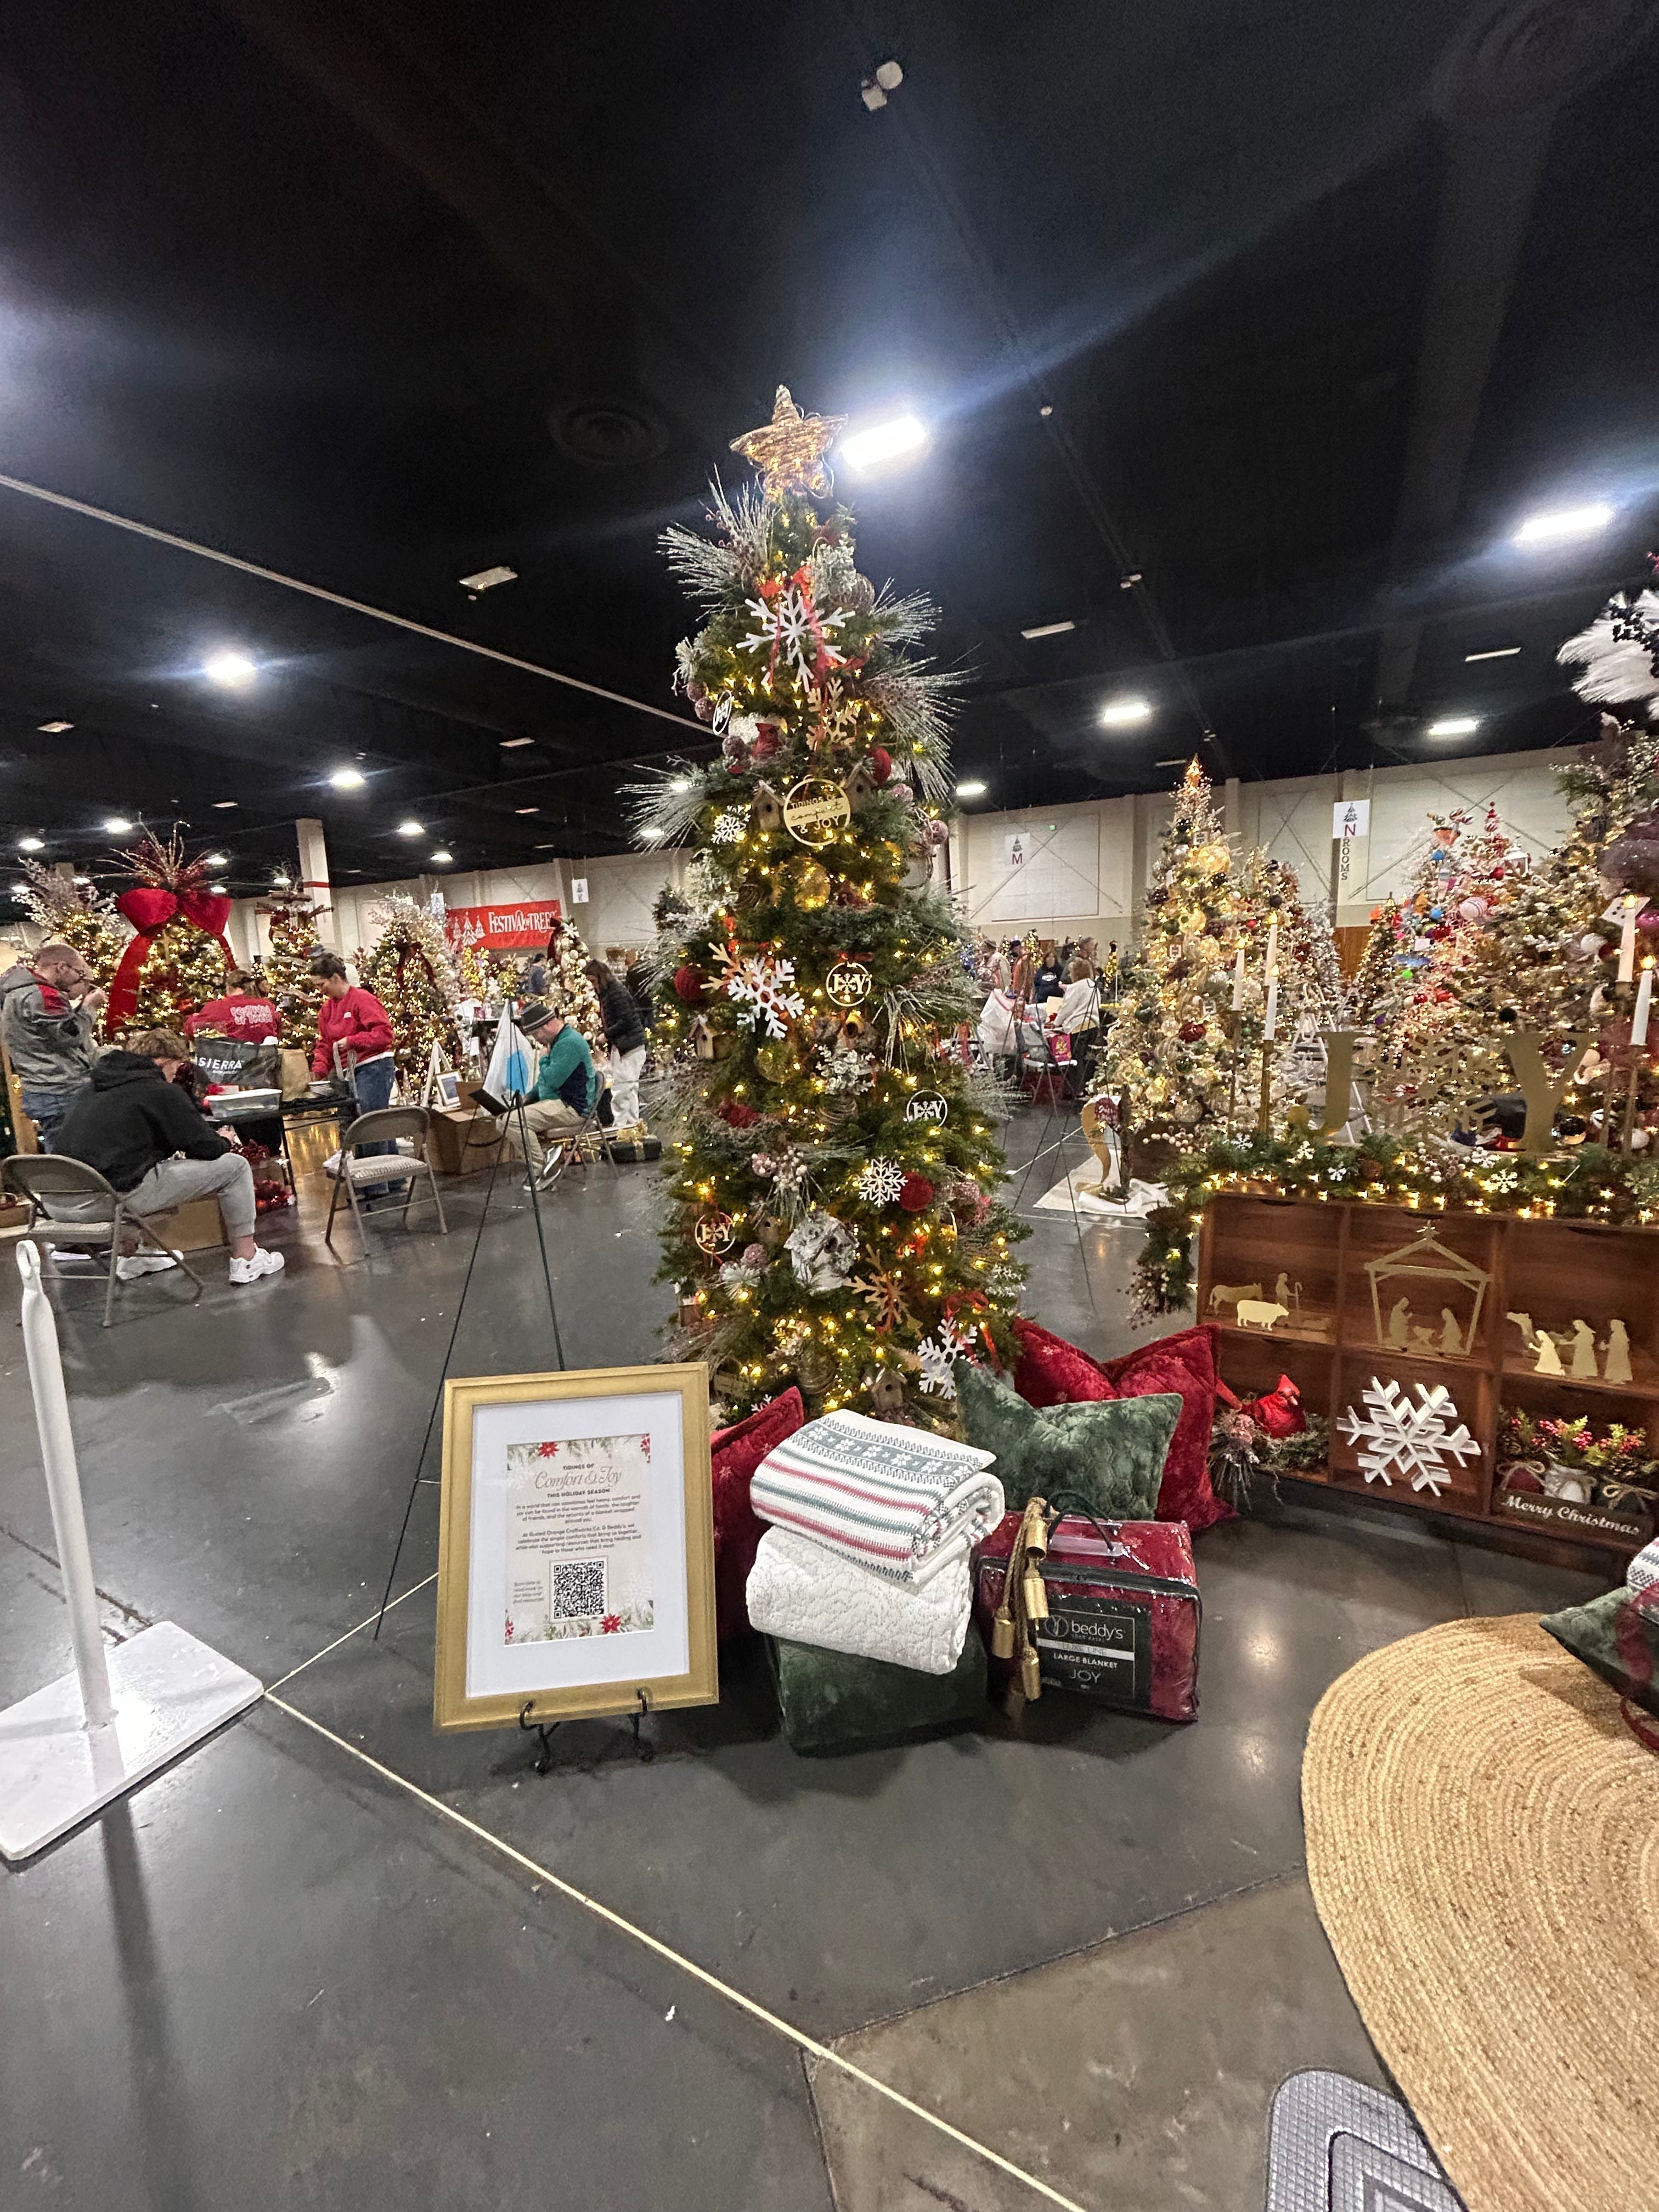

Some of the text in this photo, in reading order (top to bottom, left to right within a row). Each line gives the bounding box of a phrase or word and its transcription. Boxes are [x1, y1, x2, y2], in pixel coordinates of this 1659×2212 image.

[791, 797, 823, 809] TIDINGS
[814, 815, 840, 831] JOY
[1344, 823, 1356, 836] N
[1012, 853, 1023, 865] M
[488, 910, 527, 934] FESTIVAL
[828, 973, 869, 994] JY
[198, 1057, 242, 1070] SIERRA
[907, 1100, 944, 1122] JY
[697, 1222, 732, 1243] JY
[535, 1470, 583, 1491] Comfort
[599, 1465, 623, 1487] Joy
[1501, 1494, 1640, 1535] Merry Christmas
[1071, 1620, 1124, 1641] beddy's
[1053, 1652, 1080, 1663] LARGE
[1070, 1669, 1102, 1684] JOY
